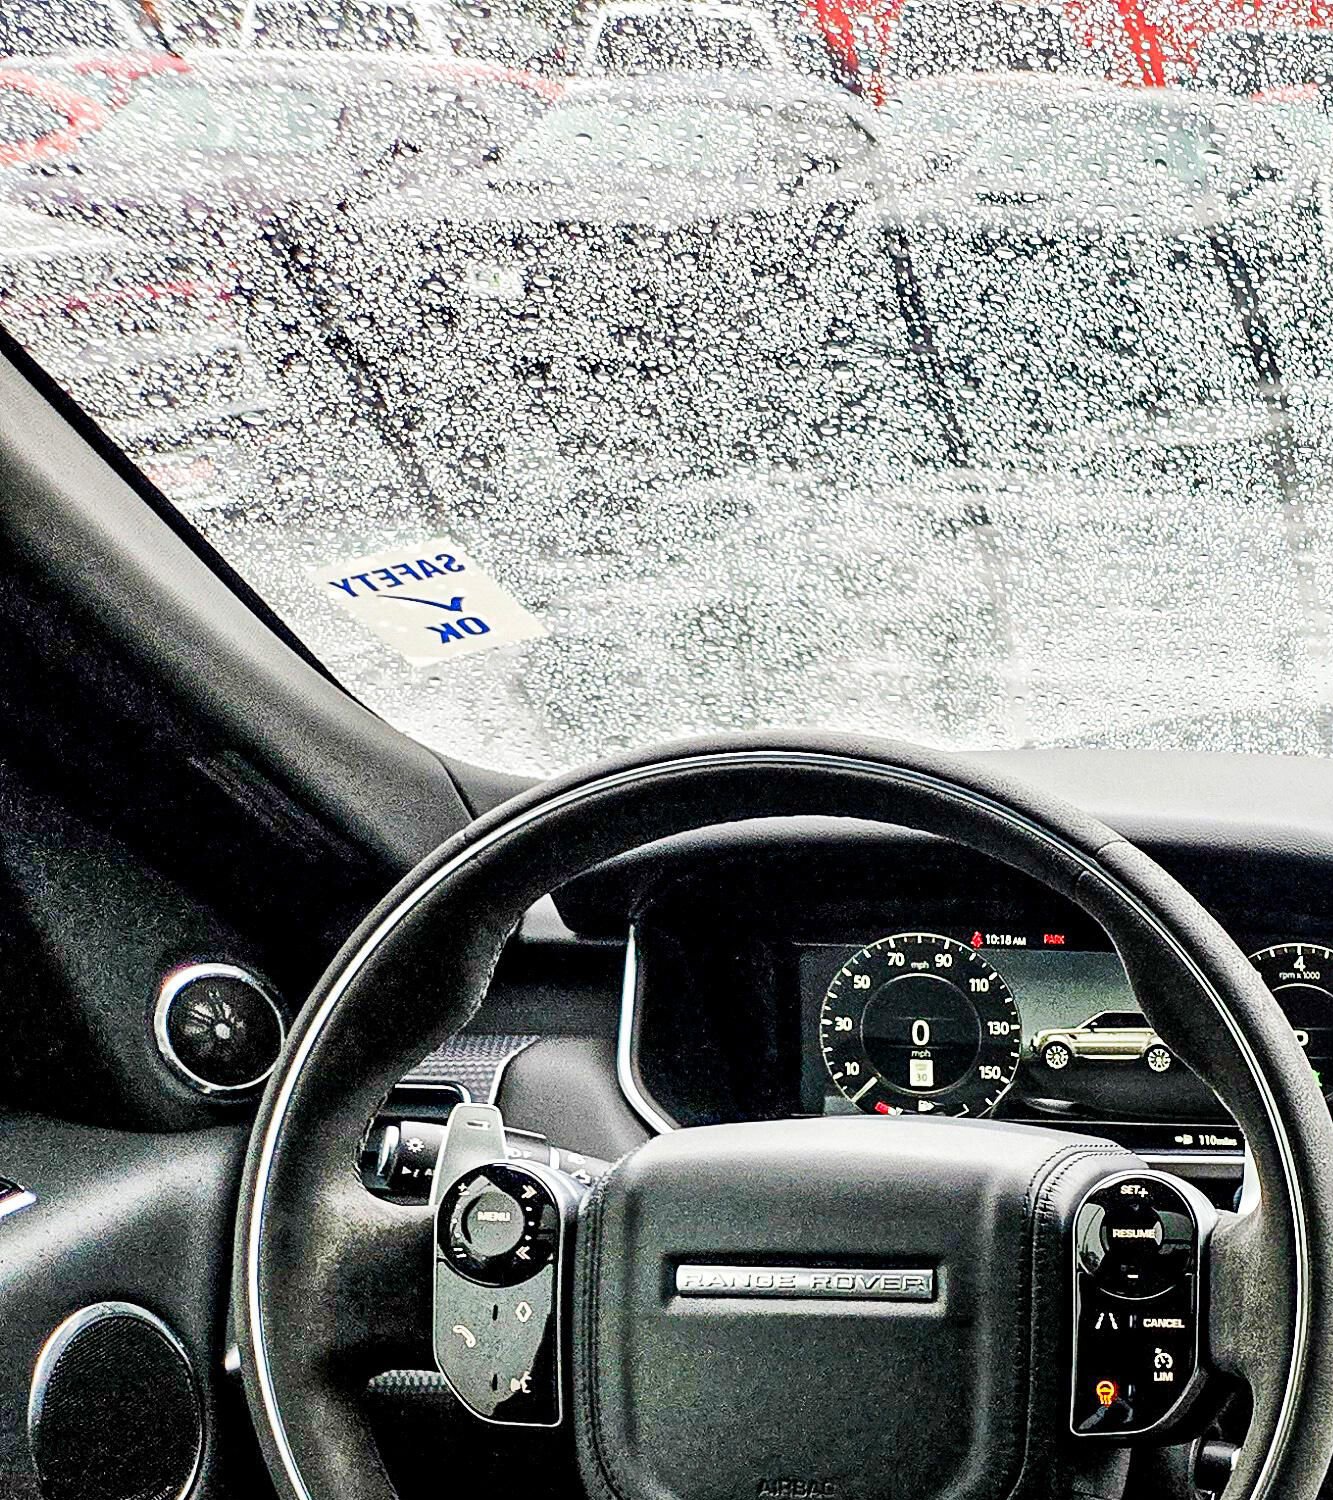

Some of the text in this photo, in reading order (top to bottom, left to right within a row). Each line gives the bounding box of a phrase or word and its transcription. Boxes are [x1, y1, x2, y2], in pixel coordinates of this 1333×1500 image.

[985, 934, 1027, 946] 10:18 AM
[1043, 933, 1065, 944] PARK
[887, 952, 905, 967] 70
[911, 960, 930, 970] mph
[935, 953, 952, 968] 90
[1293, 956, 1306, 972] 4
[853, 974, 870, 990] 50
[1279, 971, 1295, 980] rpm
[1302, 971, 1321, 980] 1000
[969, 978, 989, 992] 110
[835, 1016, 852, 1032] 30
[988, 1021, 1010, 1036] 130
[911, 1019, 930, 1046] 0
[911, 1049, 931, 1058] mph
[844, 1062, 860, 1076] 10
[979, 1066, 1001, 1080] 150
[477, 1211, 511, 1221] MENU
[1112, 1228, 1156, 1239] RESUME
[684, 1272, 931, 1293] RANGE ROVER
[1143, 1318, 1186, 1329] CANCEL
[1153, 1371, 1174, 1382] LIM
